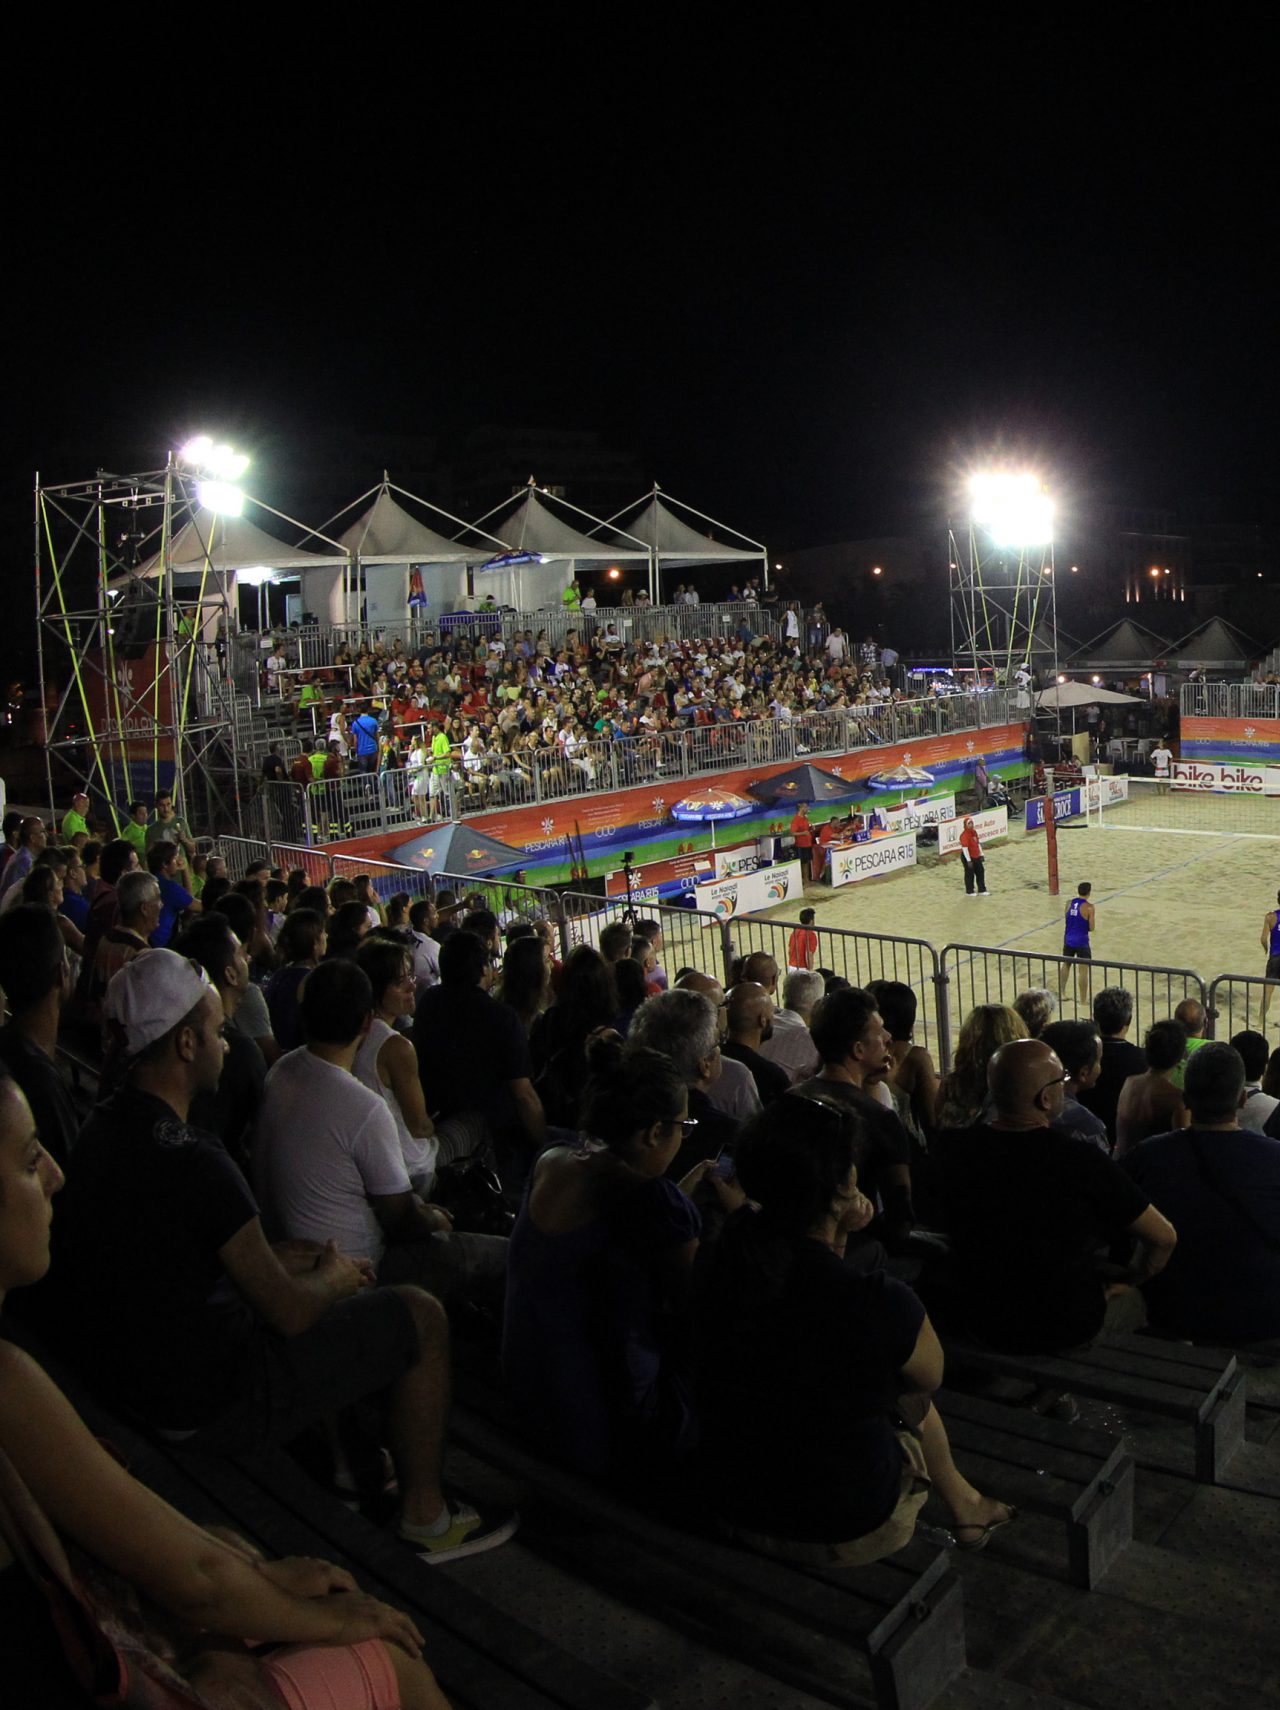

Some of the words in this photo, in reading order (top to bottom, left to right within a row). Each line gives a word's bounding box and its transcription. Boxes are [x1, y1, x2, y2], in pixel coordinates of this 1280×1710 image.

[1174, 765, 1214, 788] bike
[1221, 768, 1262, 792] bike
[855, 848, 897, 872] PESCARA
